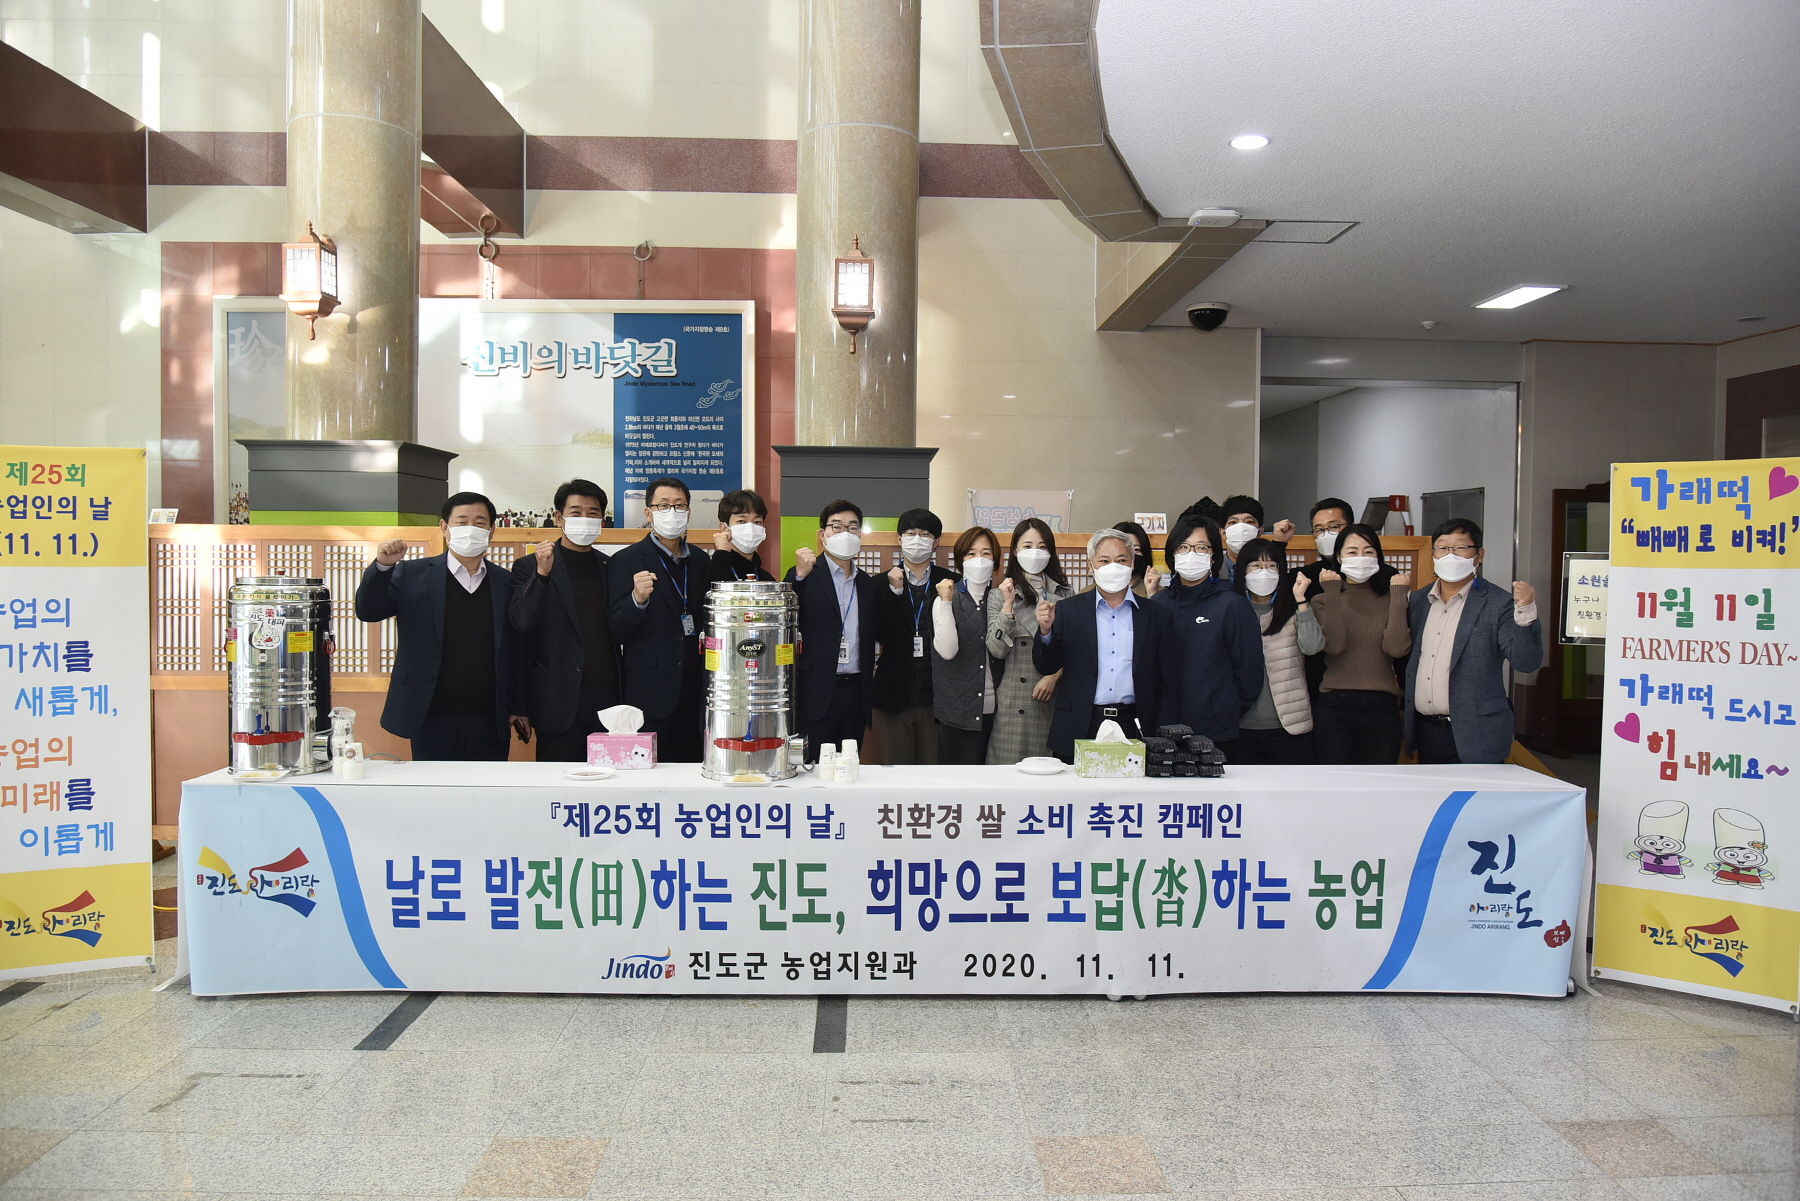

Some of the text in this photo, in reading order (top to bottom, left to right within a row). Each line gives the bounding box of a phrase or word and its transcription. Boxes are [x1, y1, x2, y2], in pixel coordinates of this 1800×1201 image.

[460, 338, 677, 378] 신비의 바닷길
[5, 462, 85, 487] 제25회
[0, 495, 112, 521] 업인의 날
[1629, 466, 1754, 522] 가래떡
[0, 531, 98, 557] 11. 11.)
[0, 598, 70, 630] 업의
[1573, 595, 1600, 604] 누구나
[1637, 587, 1775, 630] 11월 11일
[268, 618, 285, 626] 대파
[1577, 610, 1602, 621] 친환경
[0, 640, 94, 673] 가치를
[1621, 637, 1730, 664] FARMER’S
[15, 685, 117, 717] 새롭게,
[1619, 674, 1796, 725] 가래떡 드시고
[0, 736, 72, 770] 업의
[1, 778, 95, 814] 미래를
[675, 803, 791, 839] 농업인의
[877, 803, 962, 839] 친환경
[976, 804, 1006, 839] 쌀
[1017, 803, 1073, 838] 소비
[1087, 802, 1142, 838] 촉진
[1157, 803, 1241, 838] 캠페인
[20, 822, 113, 857] 이롭게
[205, 873, 243, 896] 진도
[386, 856, 466, 928] 날로
[484, 857, 732, 931] 발전(田)하는
[750, 859, 845, 935] 진도,
[866, 859, 1029, 932] 희망으로
[1308, 859, 1386, 930] 농업
[3, 917, 37, 937] 진도
[1648, 926, 1678, 946] 진도
[601, 957, 663, 980] Jindo
[688, 951, 767, 980] 진도군
[781, 951, 917, 980] 농업지원과
[964, 953, 1046, 980] 2020.
[1077, 954, 1113, 980] 11.
[1148, 953, 1184, 979] 11.
